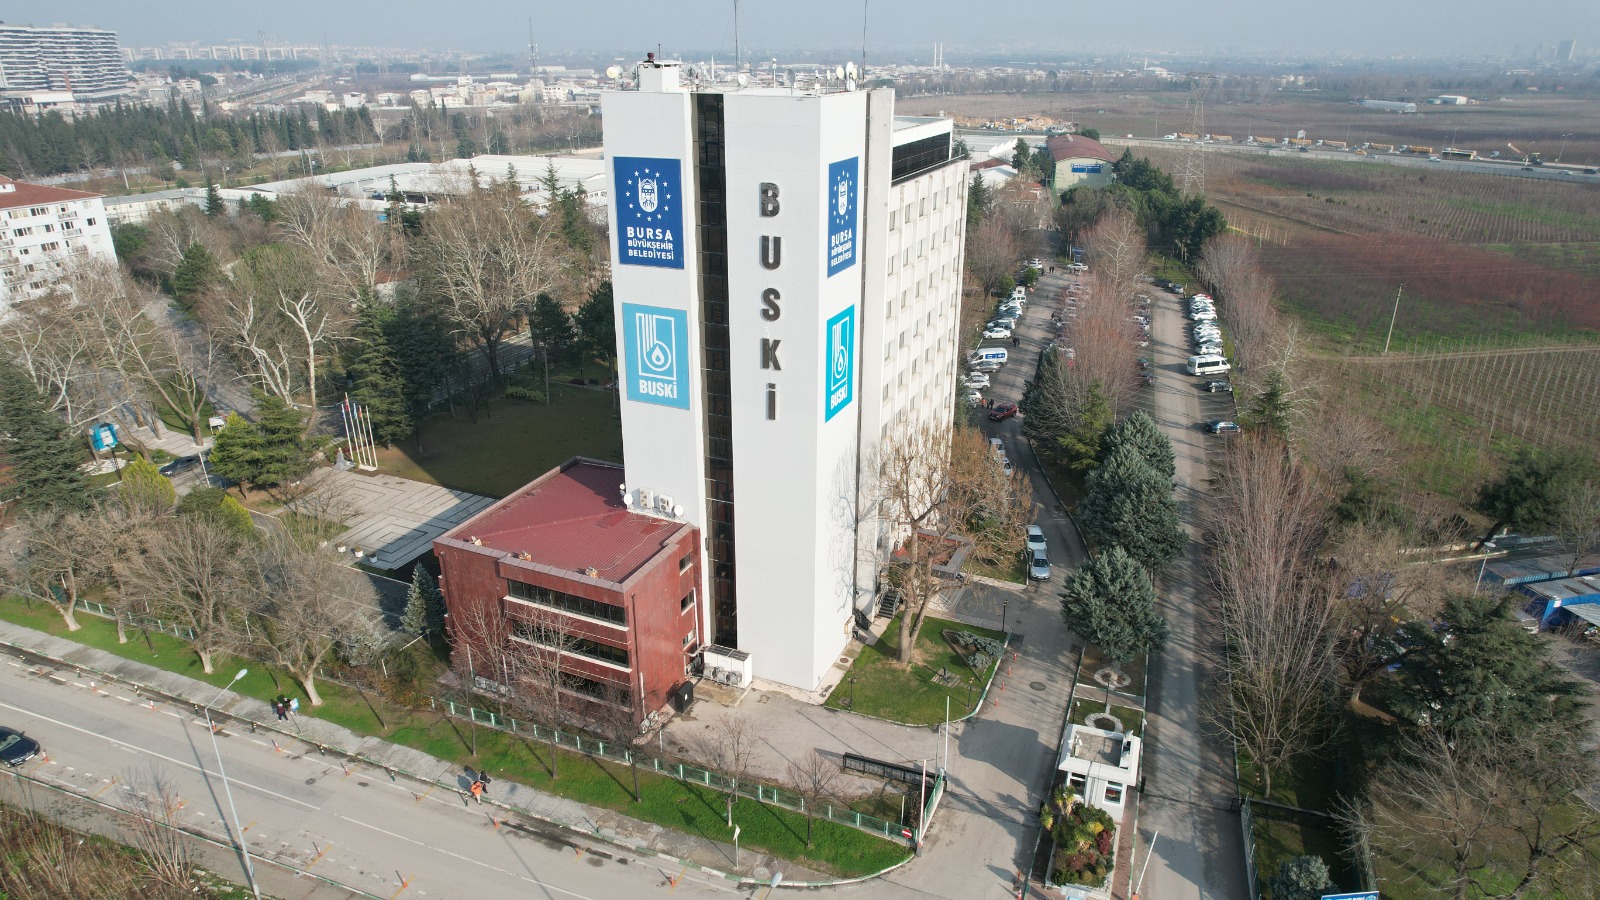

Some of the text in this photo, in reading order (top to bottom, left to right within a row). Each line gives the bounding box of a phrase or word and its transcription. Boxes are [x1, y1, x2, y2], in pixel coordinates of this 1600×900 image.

[627, 226, 674, 241] BURSA
[831, 228, 852, 247] BURSA
[627, 239, 674, 251] BÜYÜKŞEHİR
[628, 248, 674, 260] BELEDİYESİ
